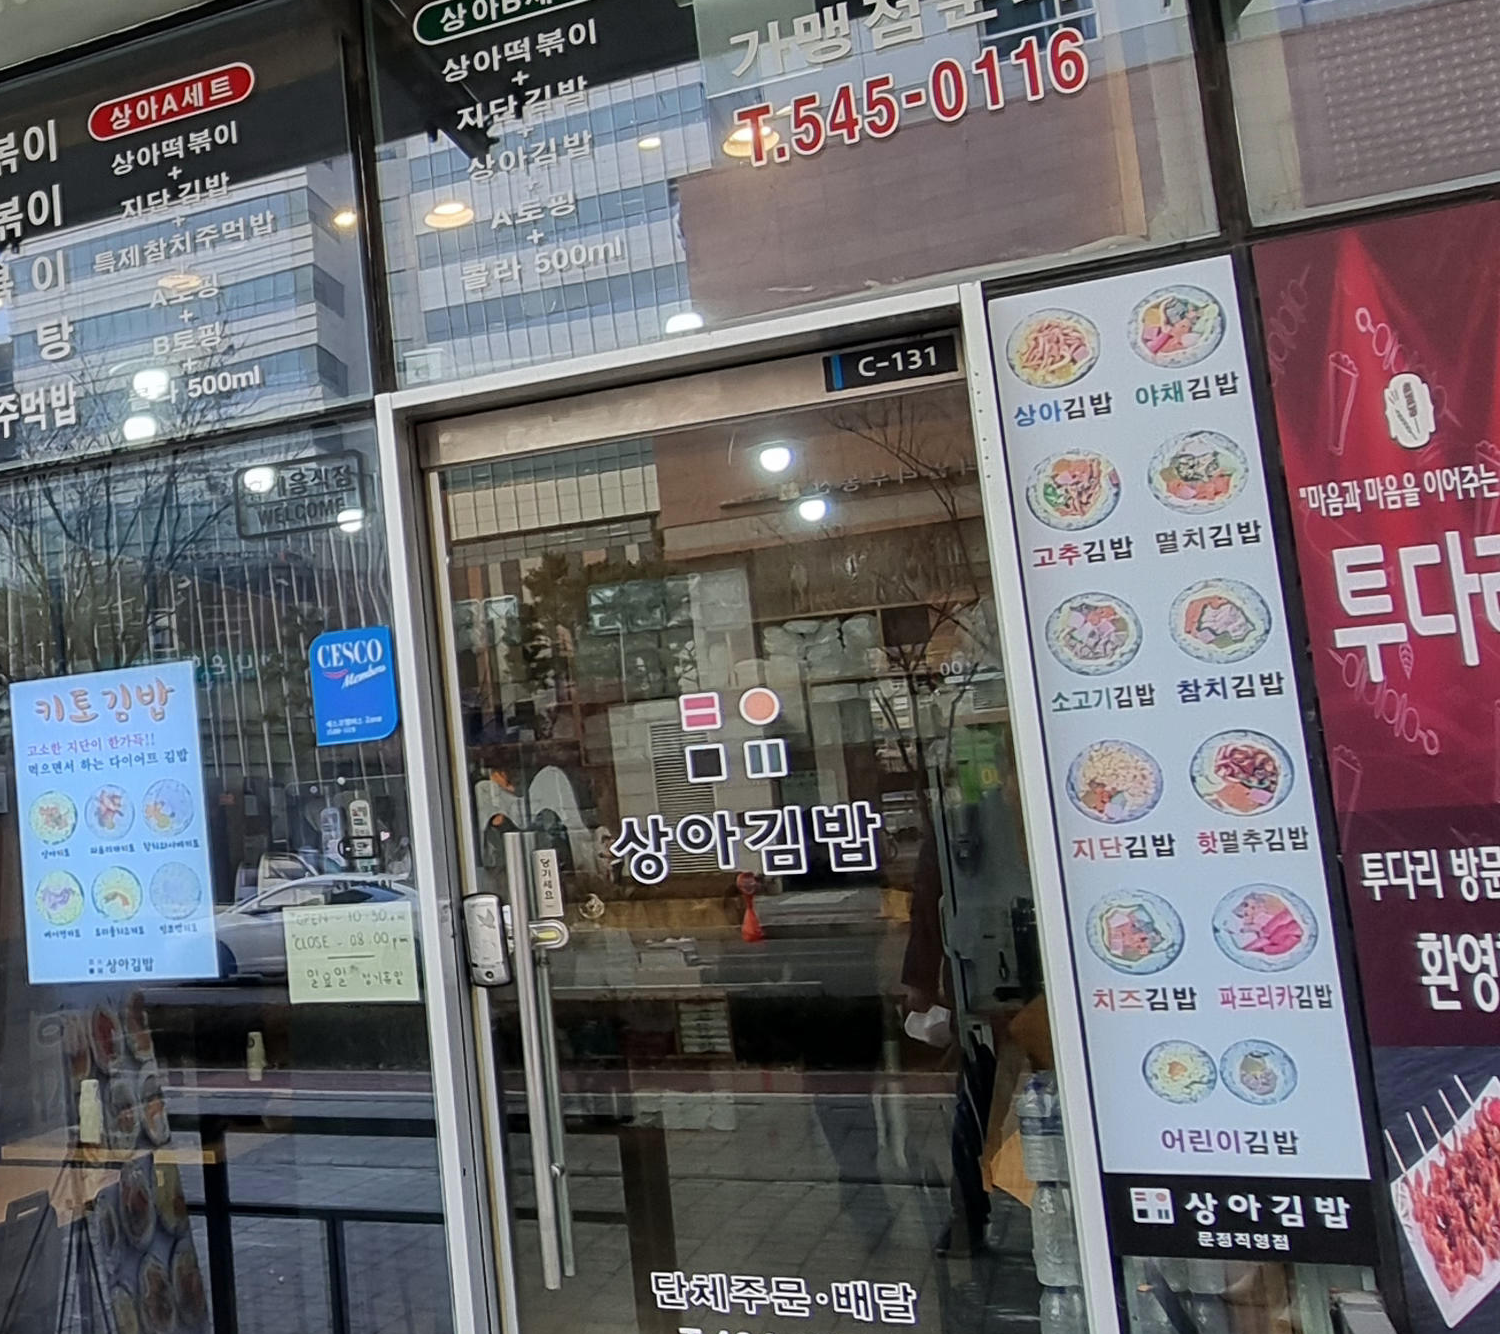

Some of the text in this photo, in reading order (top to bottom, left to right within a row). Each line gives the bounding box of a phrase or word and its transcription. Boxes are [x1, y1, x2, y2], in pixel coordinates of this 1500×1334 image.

[441, 19, 598, 83] 상아떡볶이
[109, 75, 234, 131] 상아A세트
[456, 75, 588, 131] 지단김밥
[734, 27, 1089, 166] T.545-0116
[111, 120, 239, 177] 상아떡볶이
[466, 130, 593, 183] 상아김밥
[121, 171, 230, 222] 지단김밥
[491, 192, 578, 230] A토핑
[92, 209, 277, 274] 특제참치주먹밥
[534, 235, 624, 275] 500ml
[153, 320, 227, 359] B토핑
[857, 347, 939, 377] C-131
[188, 365, 262, 399] 500ml
[1013, 370, 1240, 428] 상아김밥 야채김밥
[1363, 471, 1422, 511] 마음을
[1423, 463, 1500, 503] 이어주는
[257, 497, 347, 525] WELCOME
[1032, 519, 1262, 569] 고추김밥 멸치김밥
[1331, 530, 1500, 684] 투다
[316, 638, 383, 669] CESCO
[35, 677, 176, 724] 키토김밥
[1050, 670, 1286, 714] 소고기김밥 참치김밥
[164, 747, 189, 764] 김밥
[609, 801, 882, 885] 상아김밥
[1072, 824, 1310, 862] 지단김밥 핫멸추김밥
[1360, 848, 1445, 902] 투다리
[105, 957, 154, 974] 상아김밥
[1415, 931, 1500, 1014] 환영
[1093, 982, 1333, 1013] 치즈김밥 파프리카김밥
[1161, 1128, 1300, 1157] 어린이김밥
[1184, 1191, 1351, 1231] 상아김밥
[1197, 1230, 1291, 1253] 문정직영점
